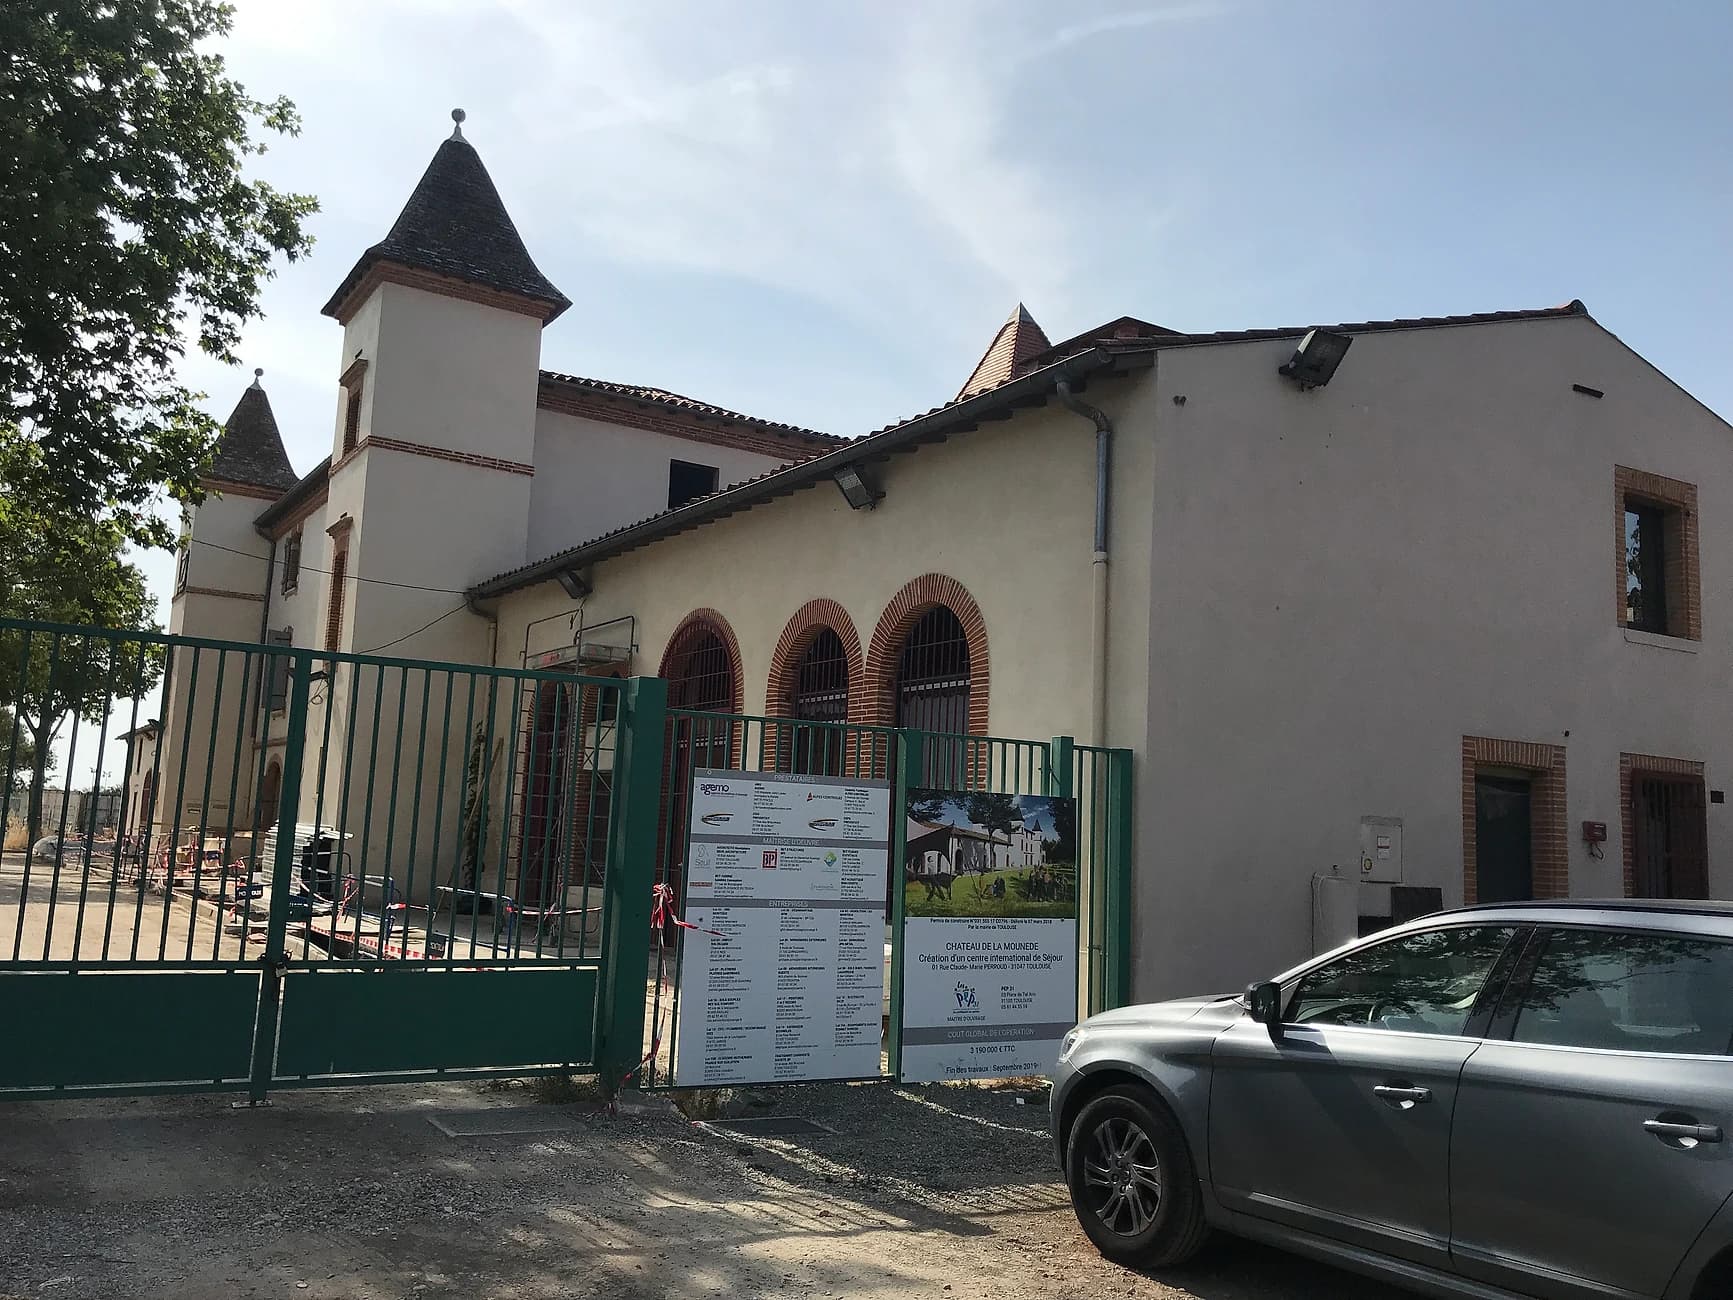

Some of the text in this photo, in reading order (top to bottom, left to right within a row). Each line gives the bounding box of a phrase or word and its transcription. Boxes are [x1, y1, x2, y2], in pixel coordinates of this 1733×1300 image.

[700, 783, 730, 795] agemo
[946, 942, 1039, 951] CHATEAU DE LA MOUNEDE
[918, 953, 950, 963] Création
[950, 953, 966, 963] d'un
[966, 955, 989, 963] centre
[989, 953, 1032, 963] international
[1032, 953, 1042, 962] de
[946, 1066, 956, 1074] Fin
[968, 1065, 989, 1073] travaux
[993, 1063, 1023, 1072] Septembre
